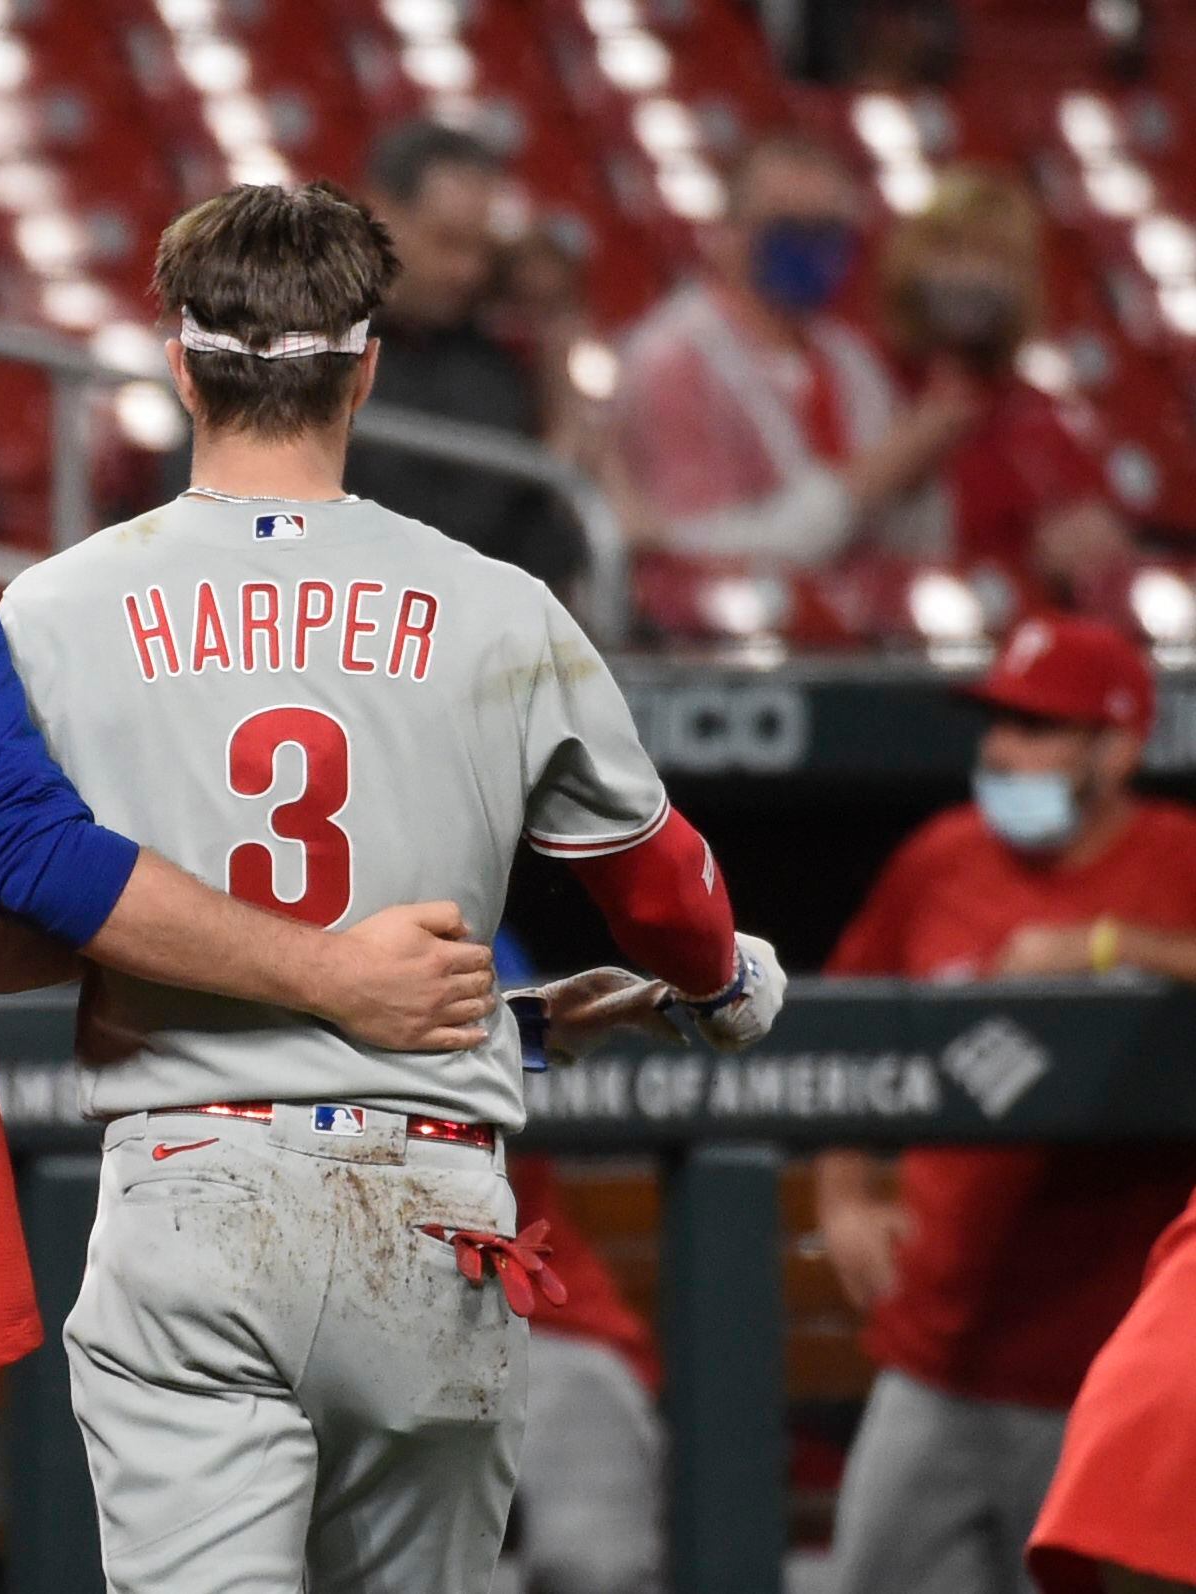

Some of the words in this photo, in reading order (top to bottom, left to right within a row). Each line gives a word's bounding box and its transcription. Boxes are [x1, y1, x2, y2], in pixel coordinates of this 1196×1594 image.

[123, 579, 440, 682] HARPER
[226, 704, 353, 931] 3
[523, 1060, 628, 1118] ANK
[708, 1055, 942, 1118] AMERICA
